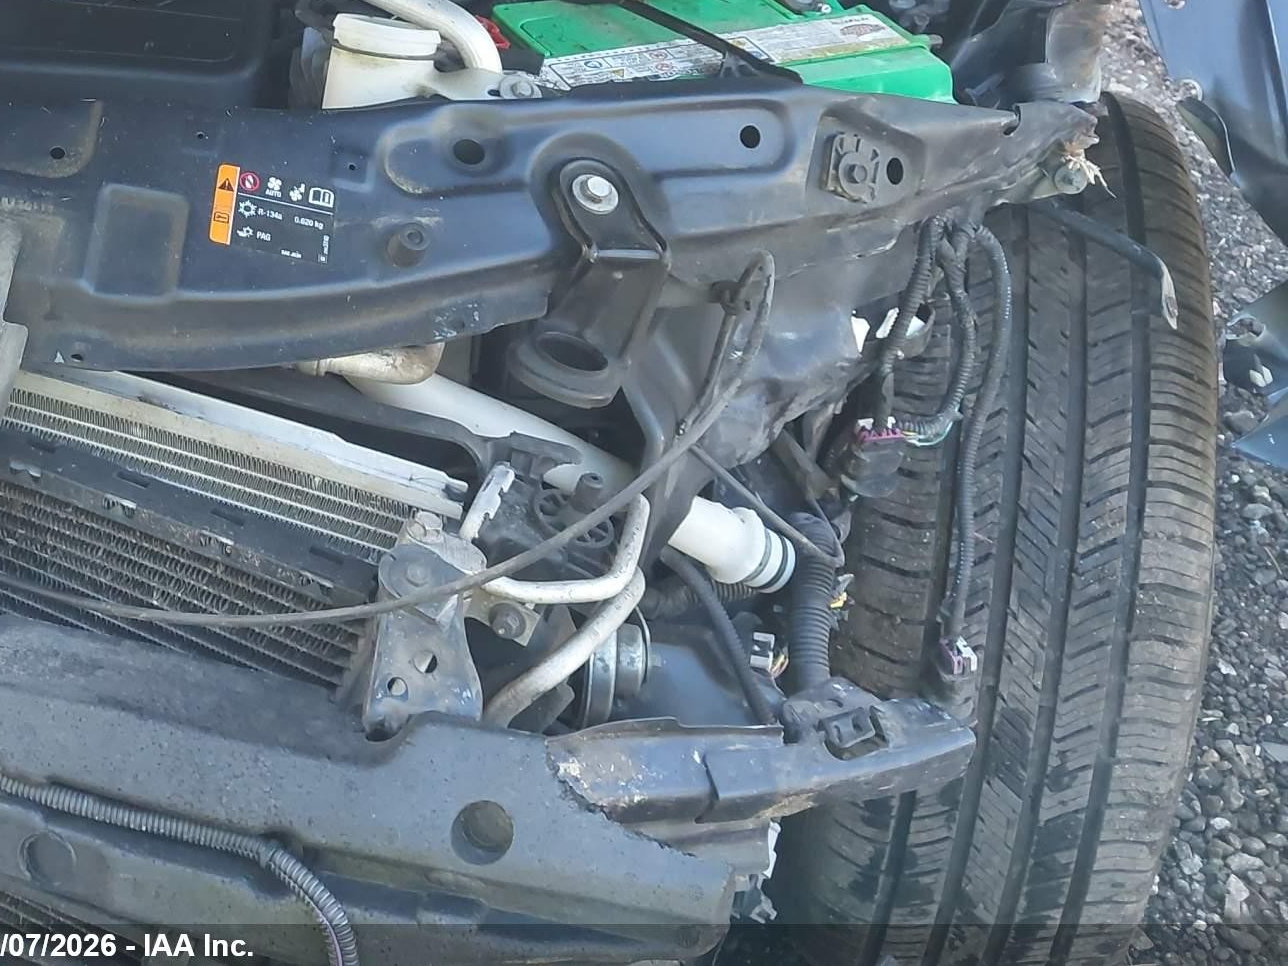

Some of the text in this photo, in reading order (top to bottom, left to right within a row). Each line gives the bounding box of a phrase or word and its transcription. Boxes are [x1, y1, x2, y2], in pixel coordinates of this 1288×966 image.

[265, 189, 281, 198] AUTO
[257, 208, 283, 220] R-134a
[314, 220, 324, 230] kg
[256, 231, 271, 241] PAG
